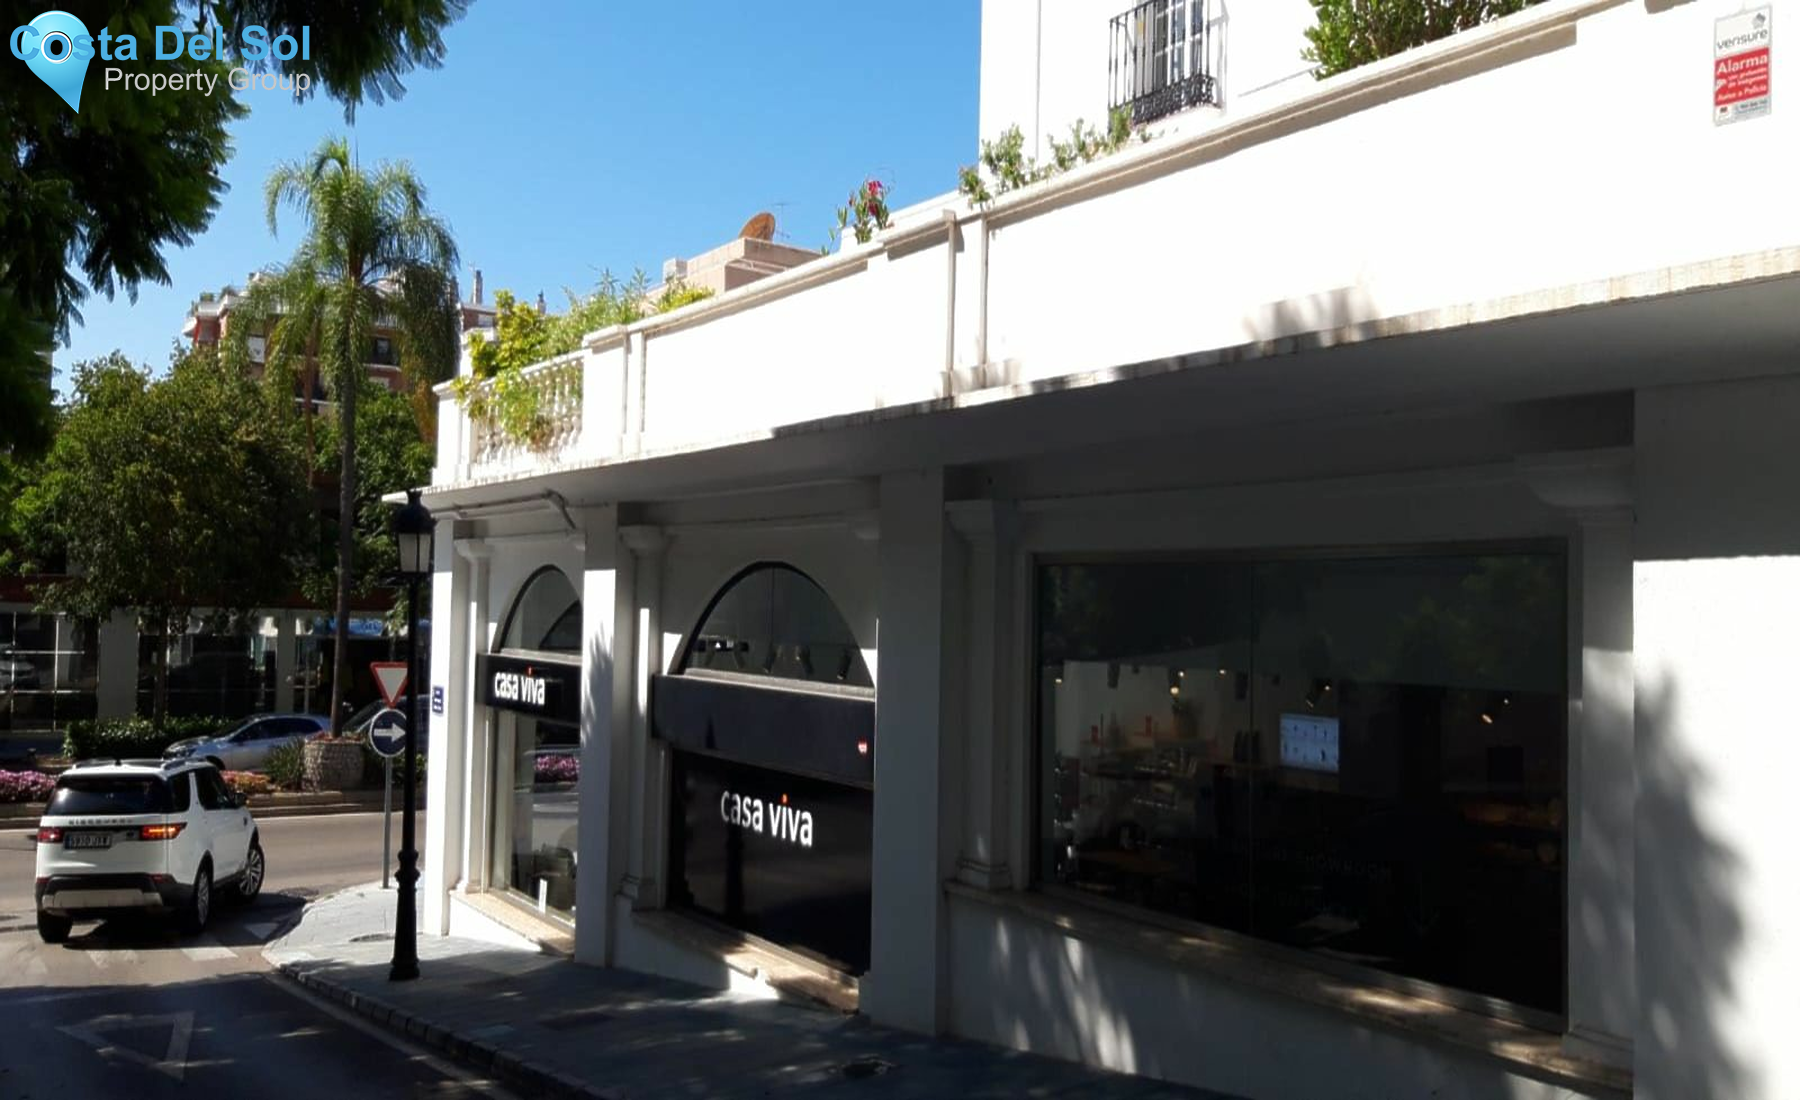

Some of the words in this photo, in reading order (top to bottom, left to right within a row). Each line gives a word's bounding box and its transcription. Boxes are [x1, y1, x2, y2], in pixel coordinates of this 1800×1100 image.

[1717, 54, 1768, 75] Alarma
[494, 672, 519, 701] casa
[521, 667, 546, 706] viva
[720, 790, 764, 833] casa
[768, 793, 814, 847] viva
